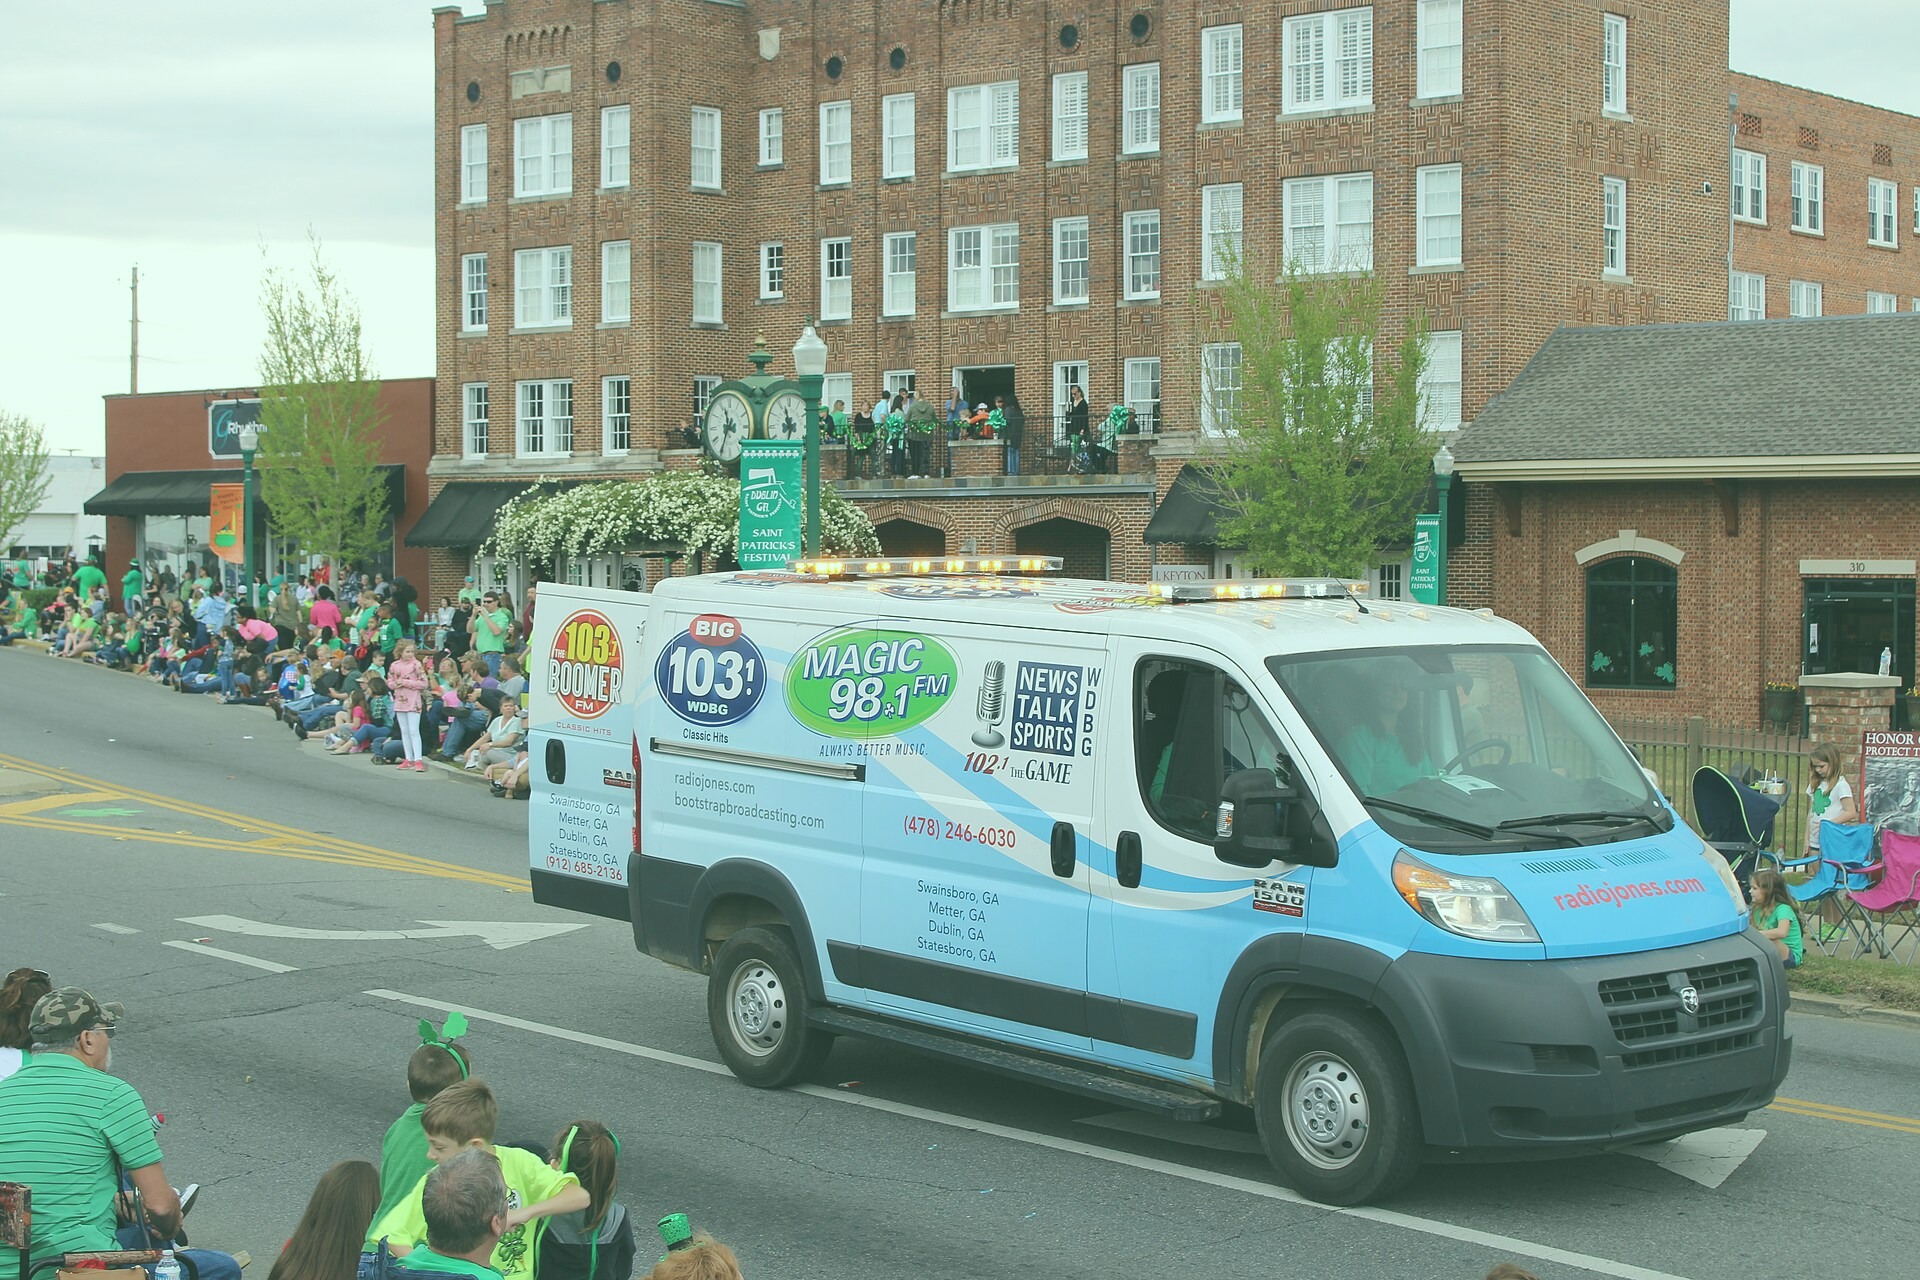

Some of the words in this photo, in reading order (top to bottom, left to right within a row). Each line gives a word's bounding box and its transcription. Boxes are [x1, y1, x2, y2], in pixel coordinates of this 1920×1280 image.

[751, 490, 779, 500] DUBLIN
[752, 528, 784, 537] SAINT
[741, 541, 796, 550] PATRICK'S
[744, 553, 791, 562] FESTIVAL
[1849, 562, 1866, 573] 310
[1163, 570, 1206, 580] KEYTON
[695, 620, 736, 638] BIG
[554, 648, 566, 659] THE
[802, 637, 925, 681] MAGIC
[548, 658, 623, 704] BOOMER
[912, 673, 949, 698] FM
[1018, 666, 1079, 696] NEWS
[575, 700, 594, 712] FM
[687, 700, 729, 716] WDBG
[1017, 693, 1075, 724] TALK
[556, 721, 591, 733] CLASSIC
[593, 726, 612, 736] HITS
[683, 728, 711, 742] Classic
[712, 731, 729, 743] Hits
[1013, 721, 1074, 752] SPORTS
[1865, 732, 1914, 745] HONOR
[819, 744, 854, 757] ALWAYS
[857, 743, 892, 756] BETTER
[895, 743, 929, 755] MUSIC.
[1865, 746, 1911, 757] PROTECT
[963, 751, 1010, 775] 102.1
[1025, 759, 1073, 784] GAME
[674, 771, 756, 795] radiojones.com
[549, 792, 603, 815] Swainsboro,
[605, 803, 621, 816] GA
[674, 791, 825, 829] bootstrapbroadcasting.com
[558, 811, 591, 829] Metter,
[593, 818, 609, 831] GA
[559, 828, 591, 846] Dublin,
[592, 835, 608, 848] GA
[904, 815, 940, 840] (478)
[945, 821, 1016, 848] 246-6030
[549, 842, 601, 864] Statesboro,
[603, 853, 619, 866] GA
[546, 855, 572, 872] (912)
[574, 861, 622, 881] 685-2136
[917, 879, 979, 904] Swainsboro,
[982, 891, 1000, 906] GA
[1254, 878, 1305, 895] RAM
[1553, 876, 1706, 911] radiojones.com
[1254, 888, 1304, 906] 1500
[928, 900, 966, 921] Metter,
[968, 908, 986, 923] GA
[928, 919, 965, 940] Dublin,
[967, 927, 985, 942] GA
[917, 936, 976, 961] Statesboro,
[979, 948, 997, 964] GA
